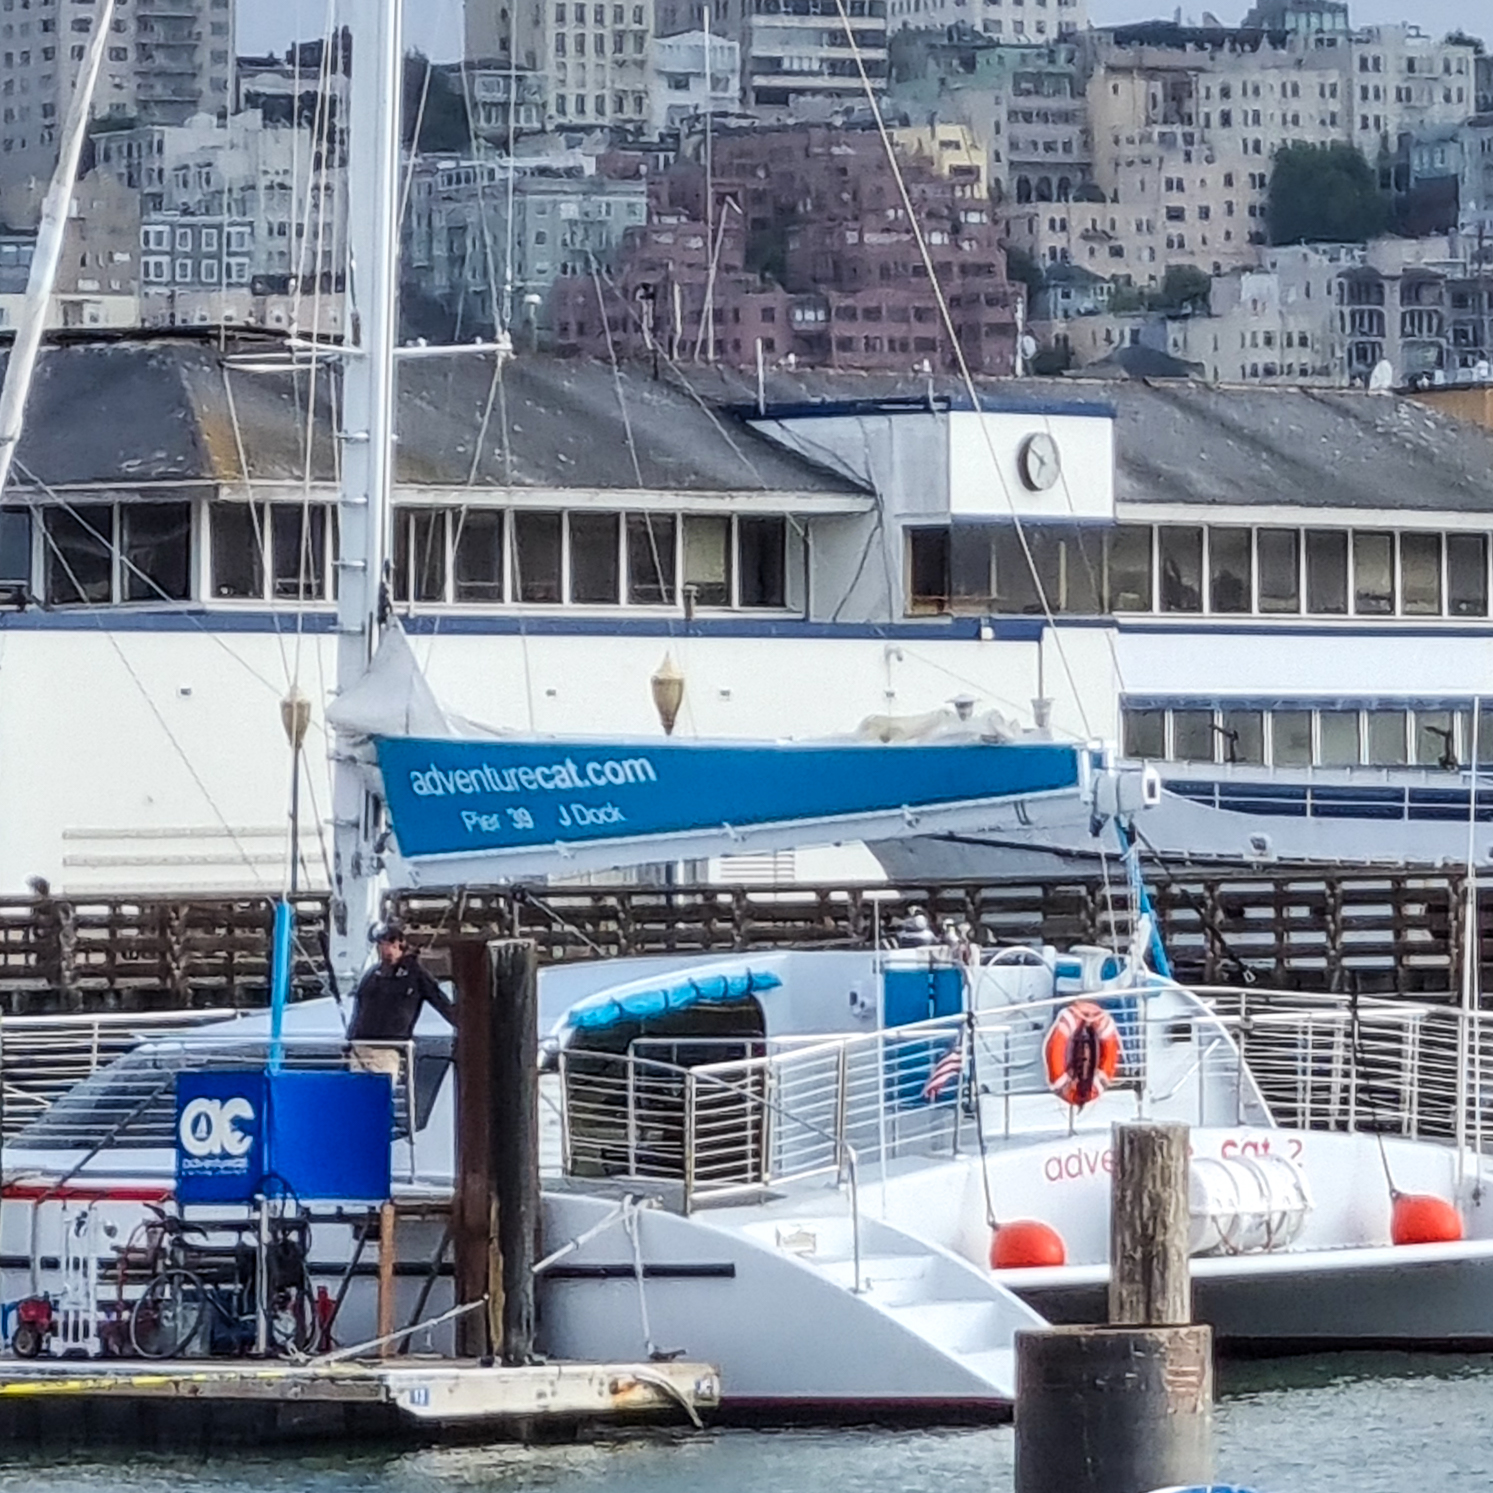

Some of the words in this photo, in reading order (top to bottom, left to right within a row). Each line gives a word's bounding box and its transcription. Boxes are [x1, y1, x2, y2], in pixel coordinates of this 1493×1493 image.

[409, 757, 658, 797] adventurecat.com
[505, 807, 535, 830] 39
[570, 801, 628, 827] Dock
